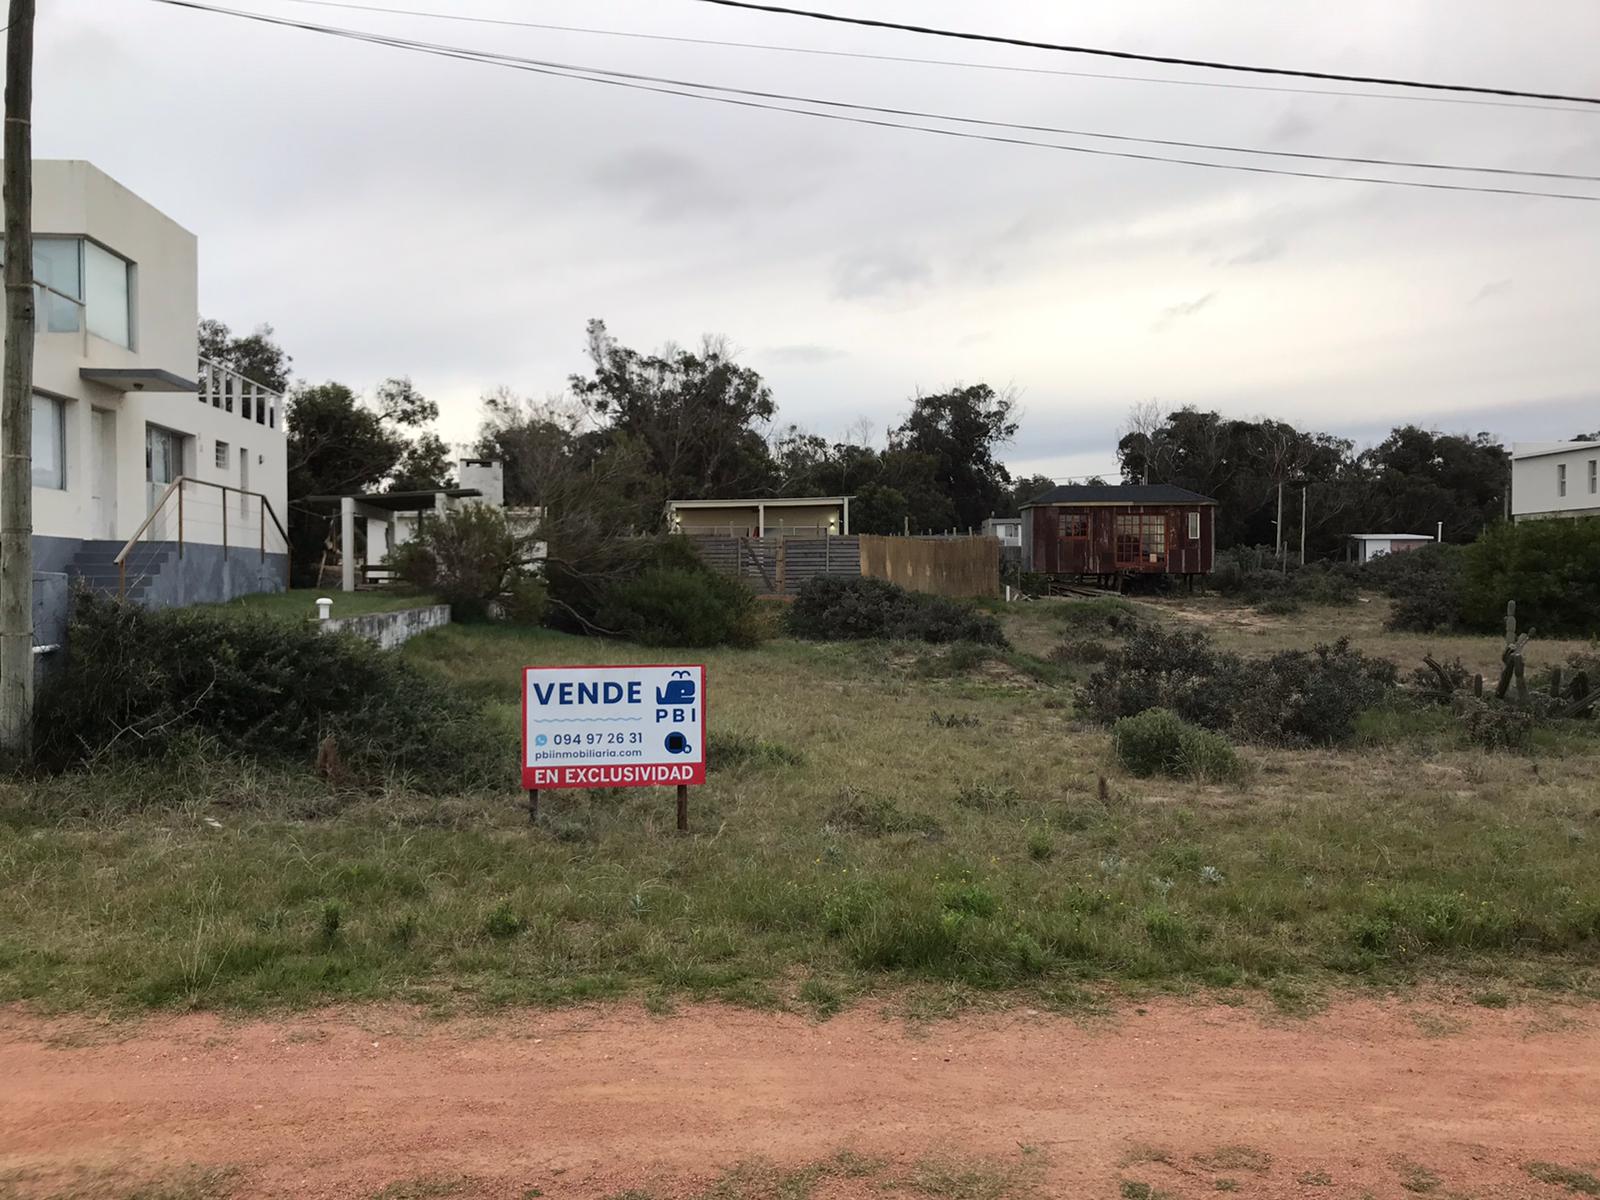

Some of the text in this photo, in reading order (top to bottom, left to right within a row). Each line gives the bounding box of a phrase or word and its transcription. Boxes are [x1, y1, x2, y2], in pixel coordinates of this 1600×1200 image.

[533, 681, 642, 705] VENDE
[655, 708, 696, 723] PBI
[553, 732, 643, 746] 094 97 26 31
[535, 749, 642, 761] pbiinmobiliaria.com
[534, 765, 694, 784] EN EXCLUSIVIDAD
